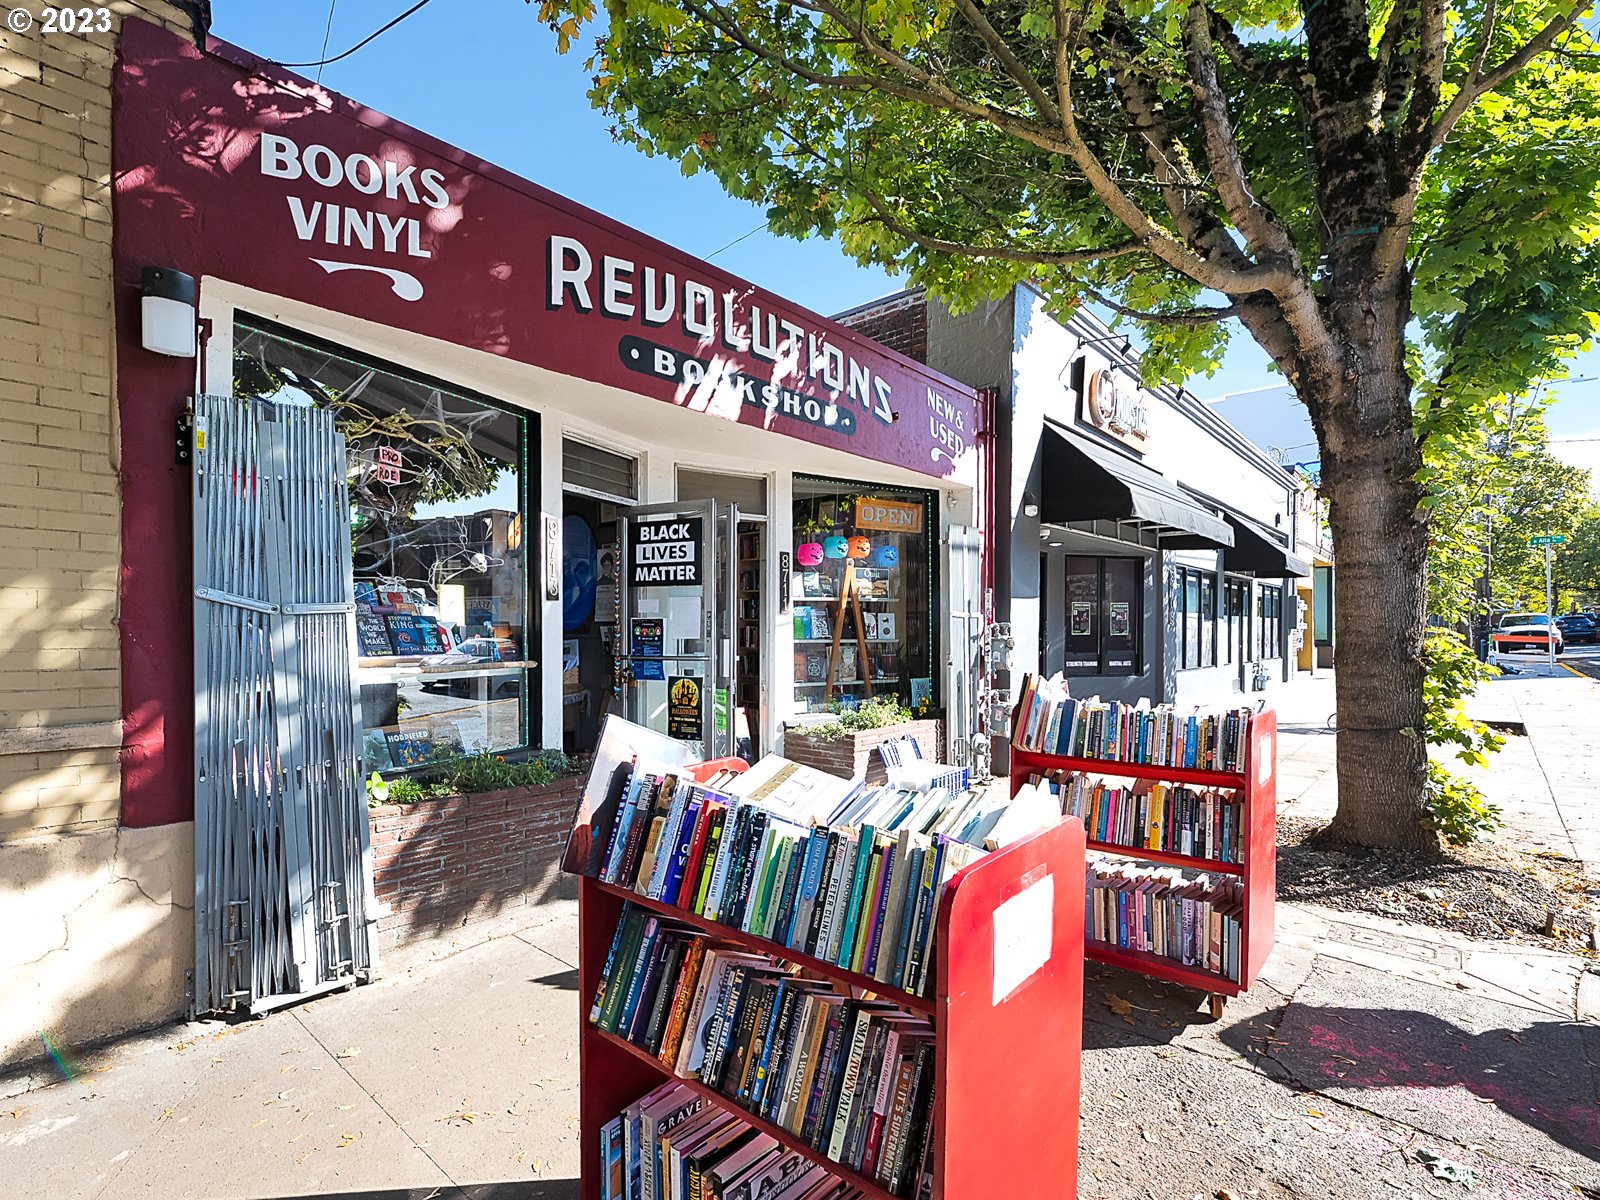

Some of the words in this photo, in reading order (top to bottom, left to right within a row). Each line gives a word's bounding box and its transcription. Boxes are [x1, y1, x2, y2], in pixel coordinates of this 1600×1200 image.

[260, 132, 450, 210] BOOKS
[286, 195, 432, 259] VINYL
[546, 235, 893, 425] REVOLUTIONS
[926, 386, 954, 423] NEW
[955, 410, 964, 432] &
[929, 415, 963, 454] USED
[862, 506, 914, 526] OPEN
[640, 523, 690, 541] BLACK
[548, 520, 558, 597] 8713
[642, 545, 688, 561] LIVES
[635, 565, 696, 581] MATTER
[780, 554, 790, 613] 8711
[863, 568, 880, 579] Ouija
[671, 707, 697, 715] HALLOWEEN
[387, 729, 428, 743] HORRIFIED
[728, 799, 737, 815] IDEAS
[722, 824, 731, 844] ACTION
[838, 835, 847, 848] EX
[748, 842, 757, 861] STUDY
[780, 835, 792, 864] Firbank
[812, 839, 824, 858] JODI
[827, 843, 836, 858] KING
[715, 850, 725, 873] CYNTHIA
[820, 857, 833, 888] SOLOMON'S
[737, 866, 751, 902] Charlotte
[775, 868, 784, 884] Two
[805, 858, 819, 890] PICOULT
[770, 884, 781, 906] Novels
[817, 888, 825, 902] RING
[826, 877, 839, 907] PETER
[920, 894, 928, 913] ATWOOD
[812, 906, 821, 929] LORENZ
[818, 908, 832, 942] CLINES
[633, 958, 643, 974] BLACK
[733, 968, 744, 986] J.A.
[604, 981, 620, 1016] Dictionary
[623, 975, 637, 1011] VENGEANCE
[674, 985, 689, 1021] dancer
[725, 986, 740, 1018] JANCE
[751, 997, 759, 1009] THE
[742, 994, 755, 1030] AMERICAN
[746, 1011, 755, 1031] FIRST
[755, 1009, 767, 1037] MADMAN
[759, 1001, 773, 1036] PROFESSOR
[839, 1006, 847, 1022] JANE
[720, 1020, 730, 1037] WEB
[783, 999, 804, 1061] INUKSHUK
[825, 1029, 835, 1049] KEEPING
[833, 1024, 843, 1051] AUSTEN
[851, 1019, 869, 1060] SMALL
[718, 1036, 726, 1047] OF
[760, 1045, 769, 1061] Bank
[809, 1032, 820, 1064] CROSSING
[714, 1046, 723, 1062] EVIL
[800, 1050, 808, 1060] A
[917, 1048, 925, 1065] Small
[789, 1060, 807, 1103] WOMAN
[844, 1057, 860, 1093] TOWN
[881, 1068, 889, 1083] the
[912, 1064, 921, 1088] Wonder
[836, 1090, 852, 1123] TALK
[875, 1082, 887, 1108] valley
[894, 1090, 906, 1113] IT'S
[901, 1110, 912, 1137] Barbara
[881, 1113, 902, 1181] SUPERMAN!
[893, 1136, 907, 1175] Kingsolver
